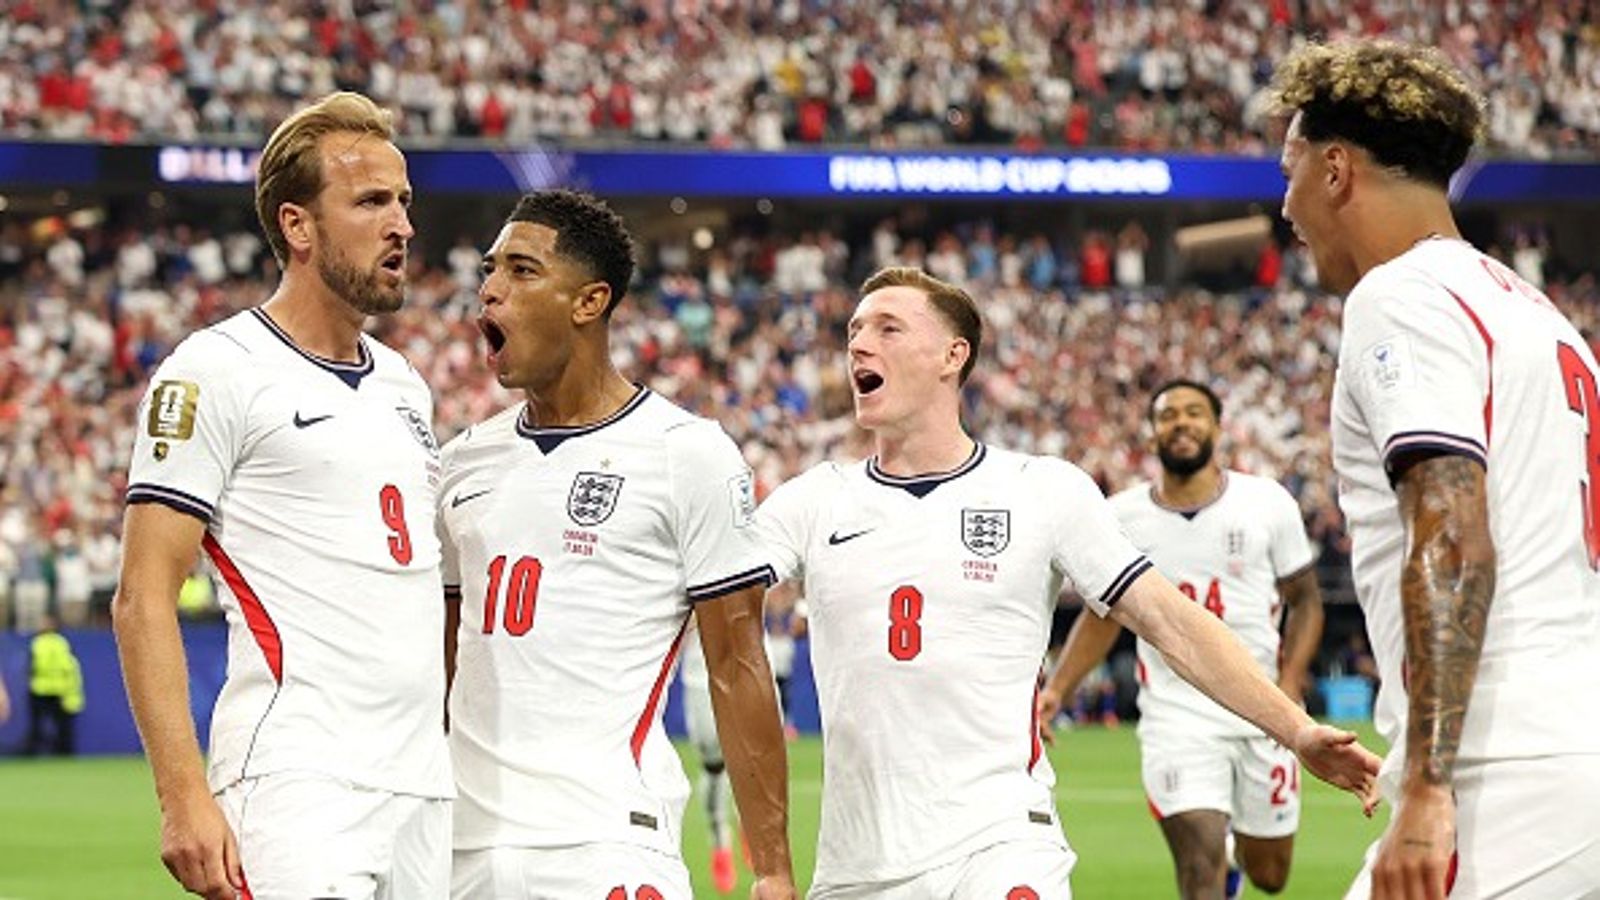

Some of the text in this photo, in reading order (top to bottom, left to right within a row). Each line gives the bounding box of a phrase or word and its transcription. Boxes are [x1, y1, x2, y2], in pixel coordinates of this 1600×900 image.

[829, 156, 895, 192] FIFA
[897, 156, 1003, 193] WORLD
[1004, 157, 1064, 192] CUP
[379, 484, 413, 566] 9
[482, 555, 543, 637] 10
[888, 585, 923, 661] 8
